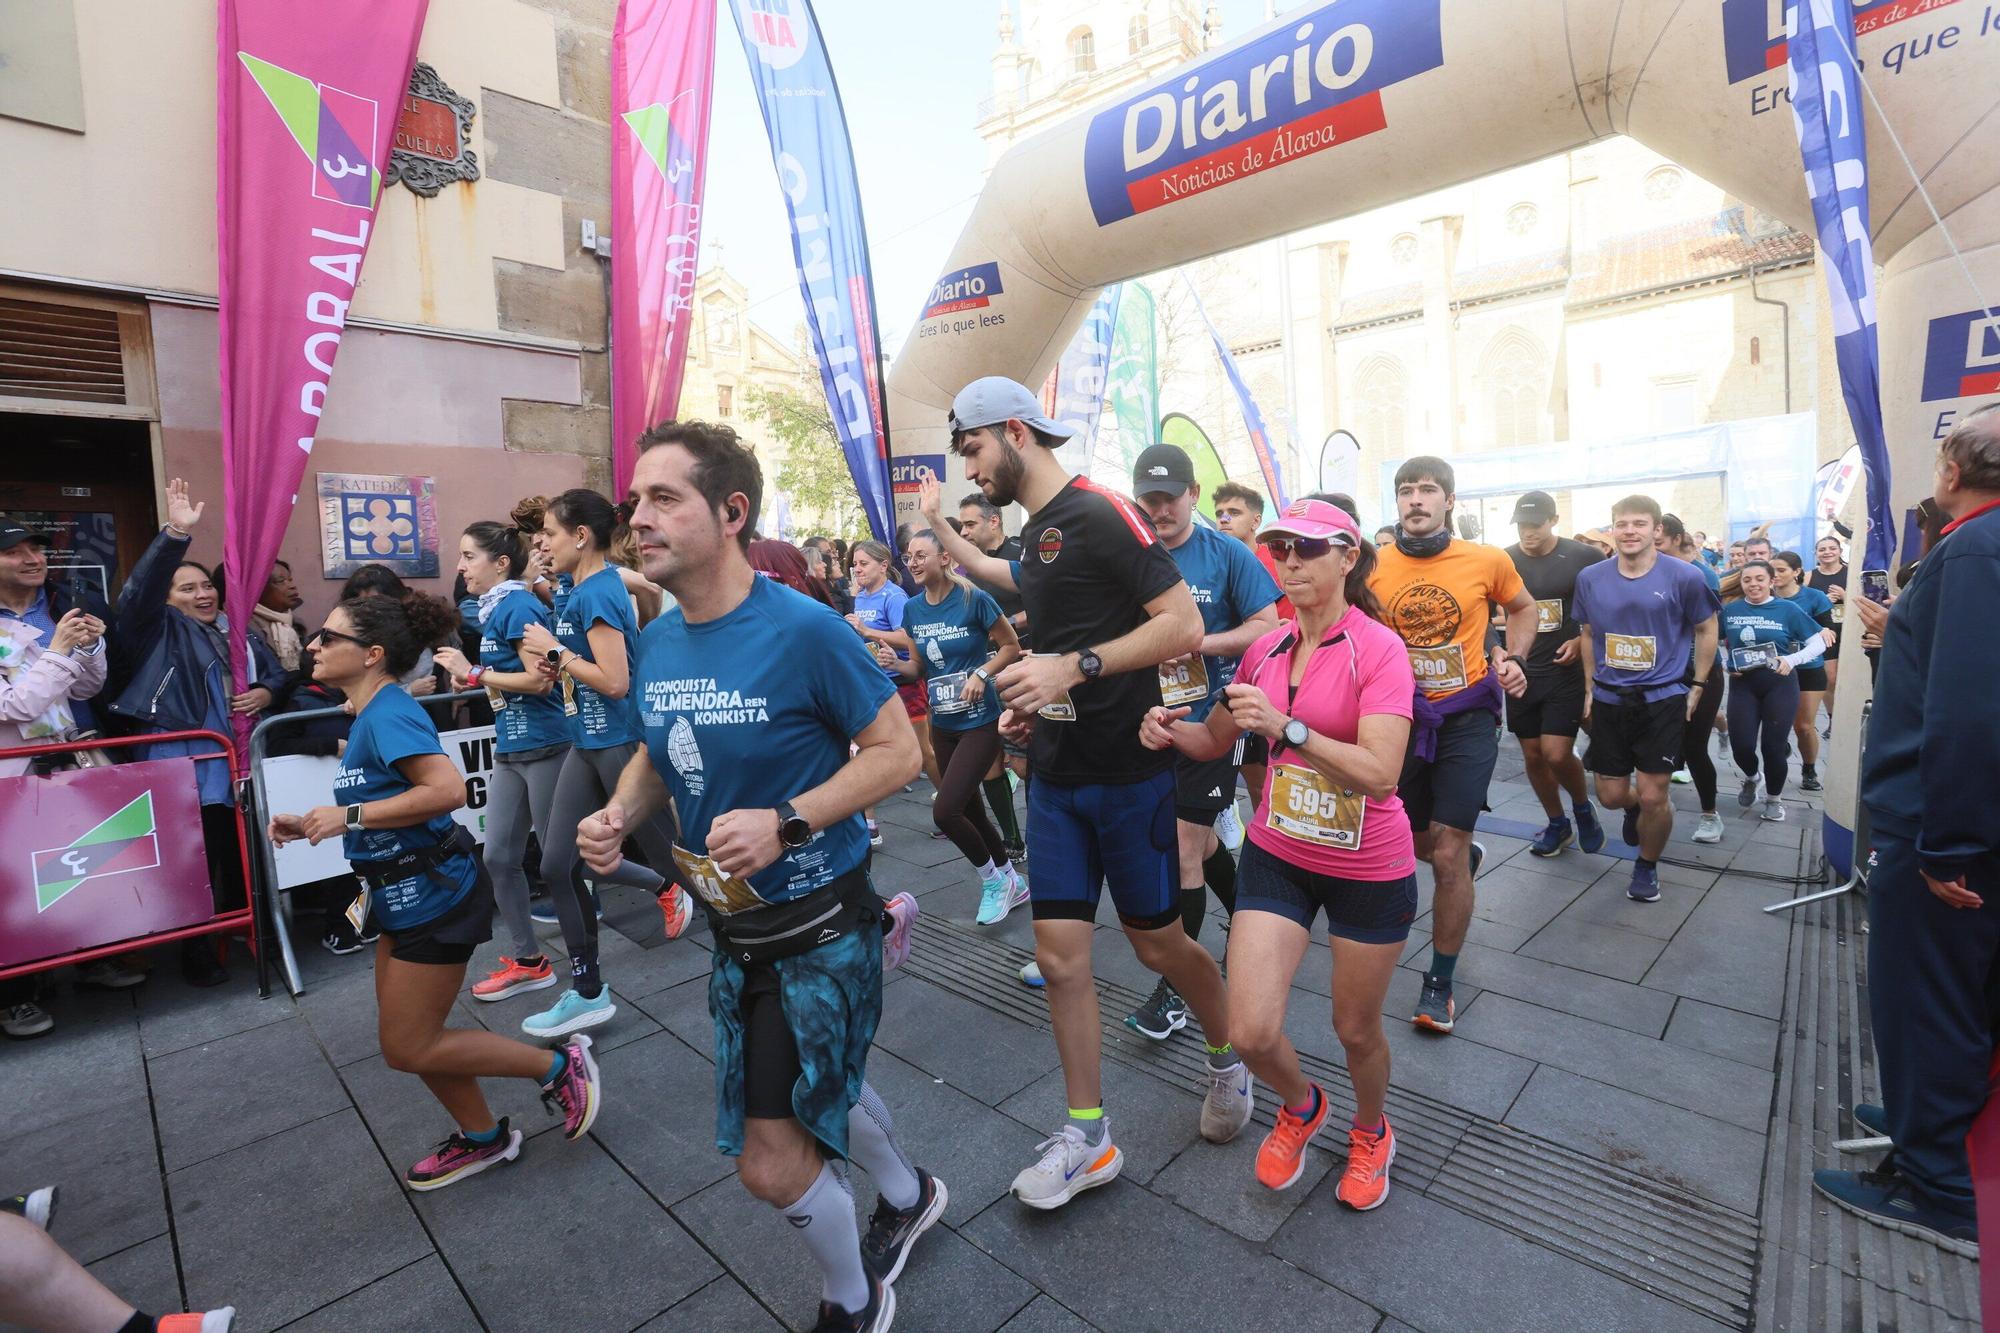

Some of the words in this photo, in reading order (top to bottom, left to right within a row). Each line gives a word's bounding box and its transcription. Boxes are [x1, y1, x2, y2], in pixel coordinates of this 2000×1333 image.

[1883, 7, 1907, 23] de
[1883, 26, 1960, 75] que
[1123, 22, 1374, 172] Diario
[1161, 160, 1235, 200] Noticias
[1241, 147, 1263, 177] de
[1269, 122, 1336, 163] Álava
[929, 272, 986, 306] Diario
[920, 325, 937, 338] Eres
[940, 320, 949, 334] lo
[953, 319, 975, 335] que
[979, 314, 1005, 328] lees
[898, 501, 914, 513] que
[917, 622, 945, 631] CONQUISTA
[919, 626, 958, 638] ALMENDRA
[938, 632, 969, 642] KONKISTA
[1615, 644, 1642, 657] 693
[1413, 659, 1447, 676] 390
[645, 682, 654, 694] LA
[654, 678, 716, 695] CONQUISTA
[936, 674, 955, 701] 987
[653, 690, 743, 711] ALMENDRA
[744, 698, 767, 707] REN
[694, 708, 769, 726] KONKISTA
[347, 767, 364, 778] REN
[1288, 783, 1337, 819] 595
[1298, 814, 1320, 826] LAURA
